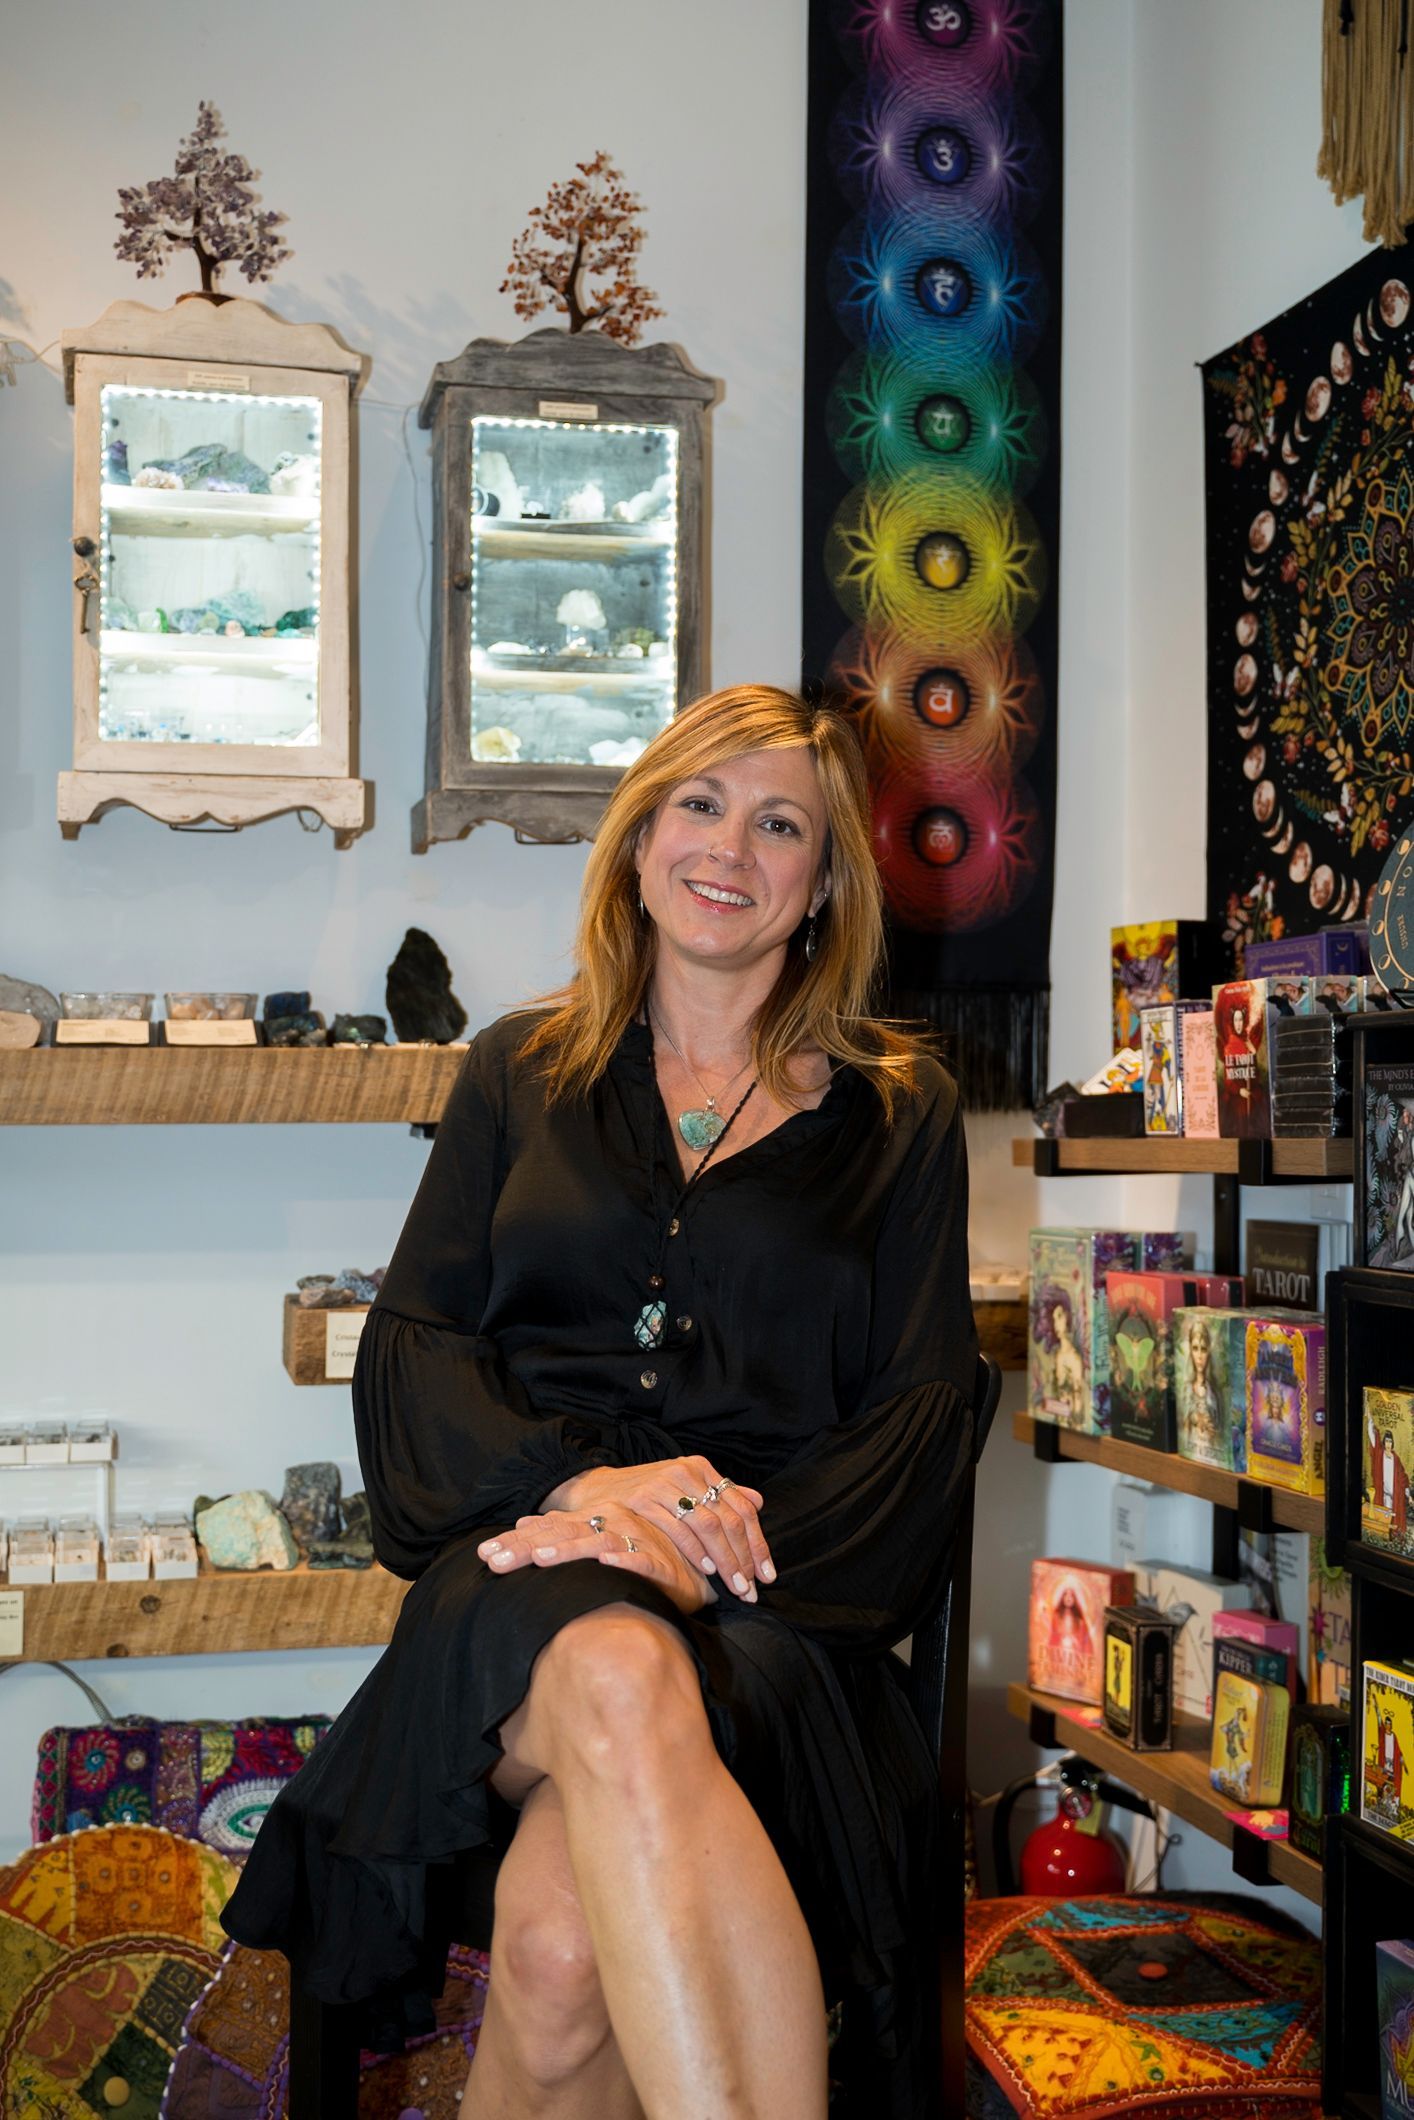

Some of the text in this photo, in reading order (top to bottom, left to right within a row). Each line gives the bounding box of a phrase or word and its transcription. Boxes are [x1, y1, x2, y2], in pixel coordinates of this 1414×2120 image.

[1368, 1070, 1382, 1081] THE
[1252, 1267, 1311, 1303] TAROT
[1318, 1346, 1326, 1395] RADLEIGH
[1372, 1407, 1405, 1423] UNIVERSAL
[1375, 1399, 1401, 1412] GOLDEN
[1378, 1418, 1398, 1430] TAROT
[1313, 1439, 1325, 1480] ANGEL
[1218, 1649, 1253, 1675] KIPPER
[1375, 1670, 1389, 1684] RIDER
[1390, 1675, 1406, 1692] TAROT
